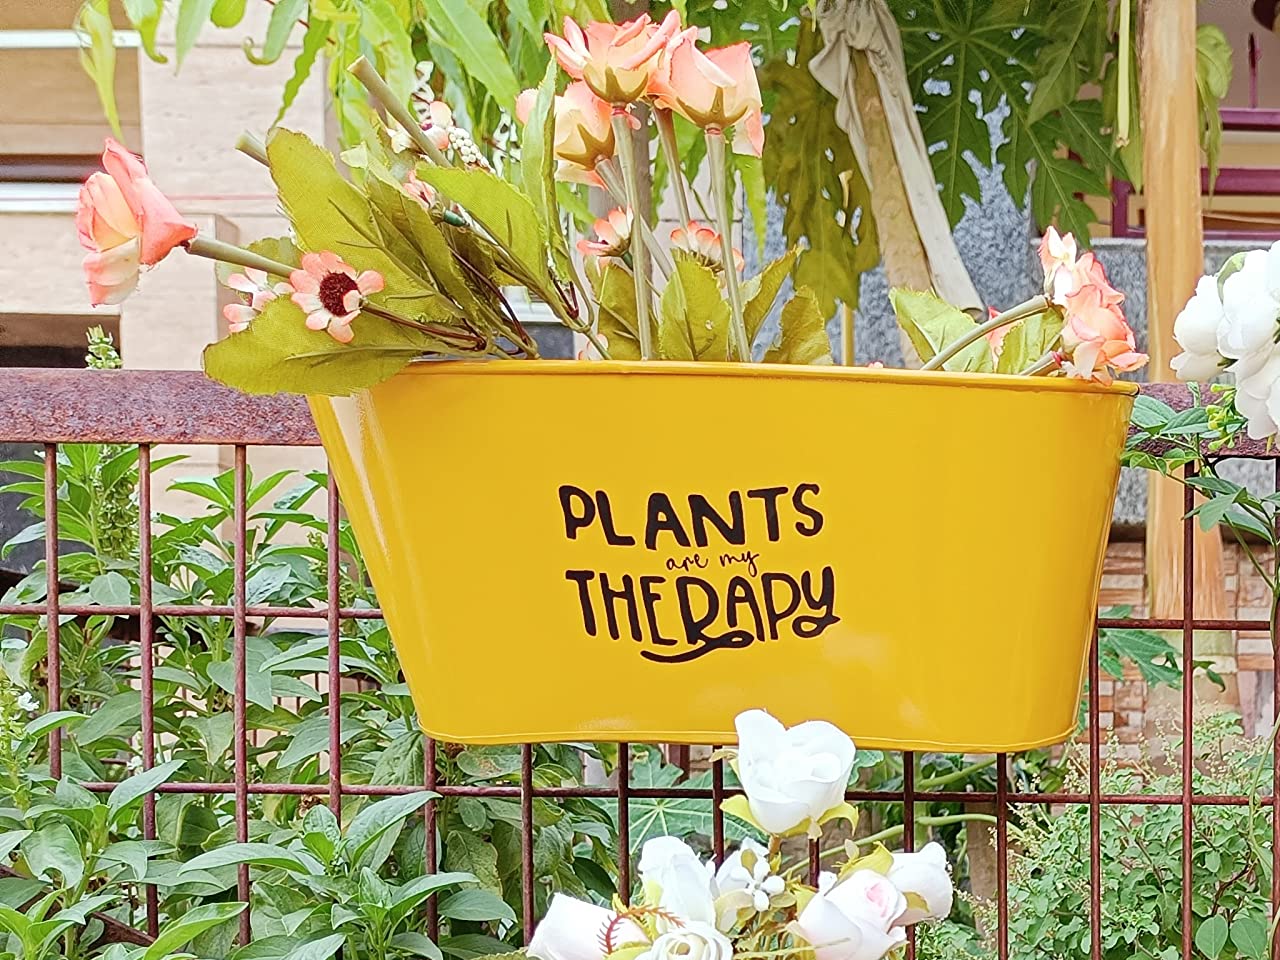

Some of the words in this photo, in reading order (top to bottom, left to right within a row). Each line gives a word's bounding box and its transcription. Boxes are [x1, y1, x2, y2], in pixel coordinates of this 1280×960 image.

[558, 483, 824, 551] PLANTS
[666, 553, 709, 572] are
[719, 550, 760, 577] my
[565, 566, 841, 663] THERAPY
